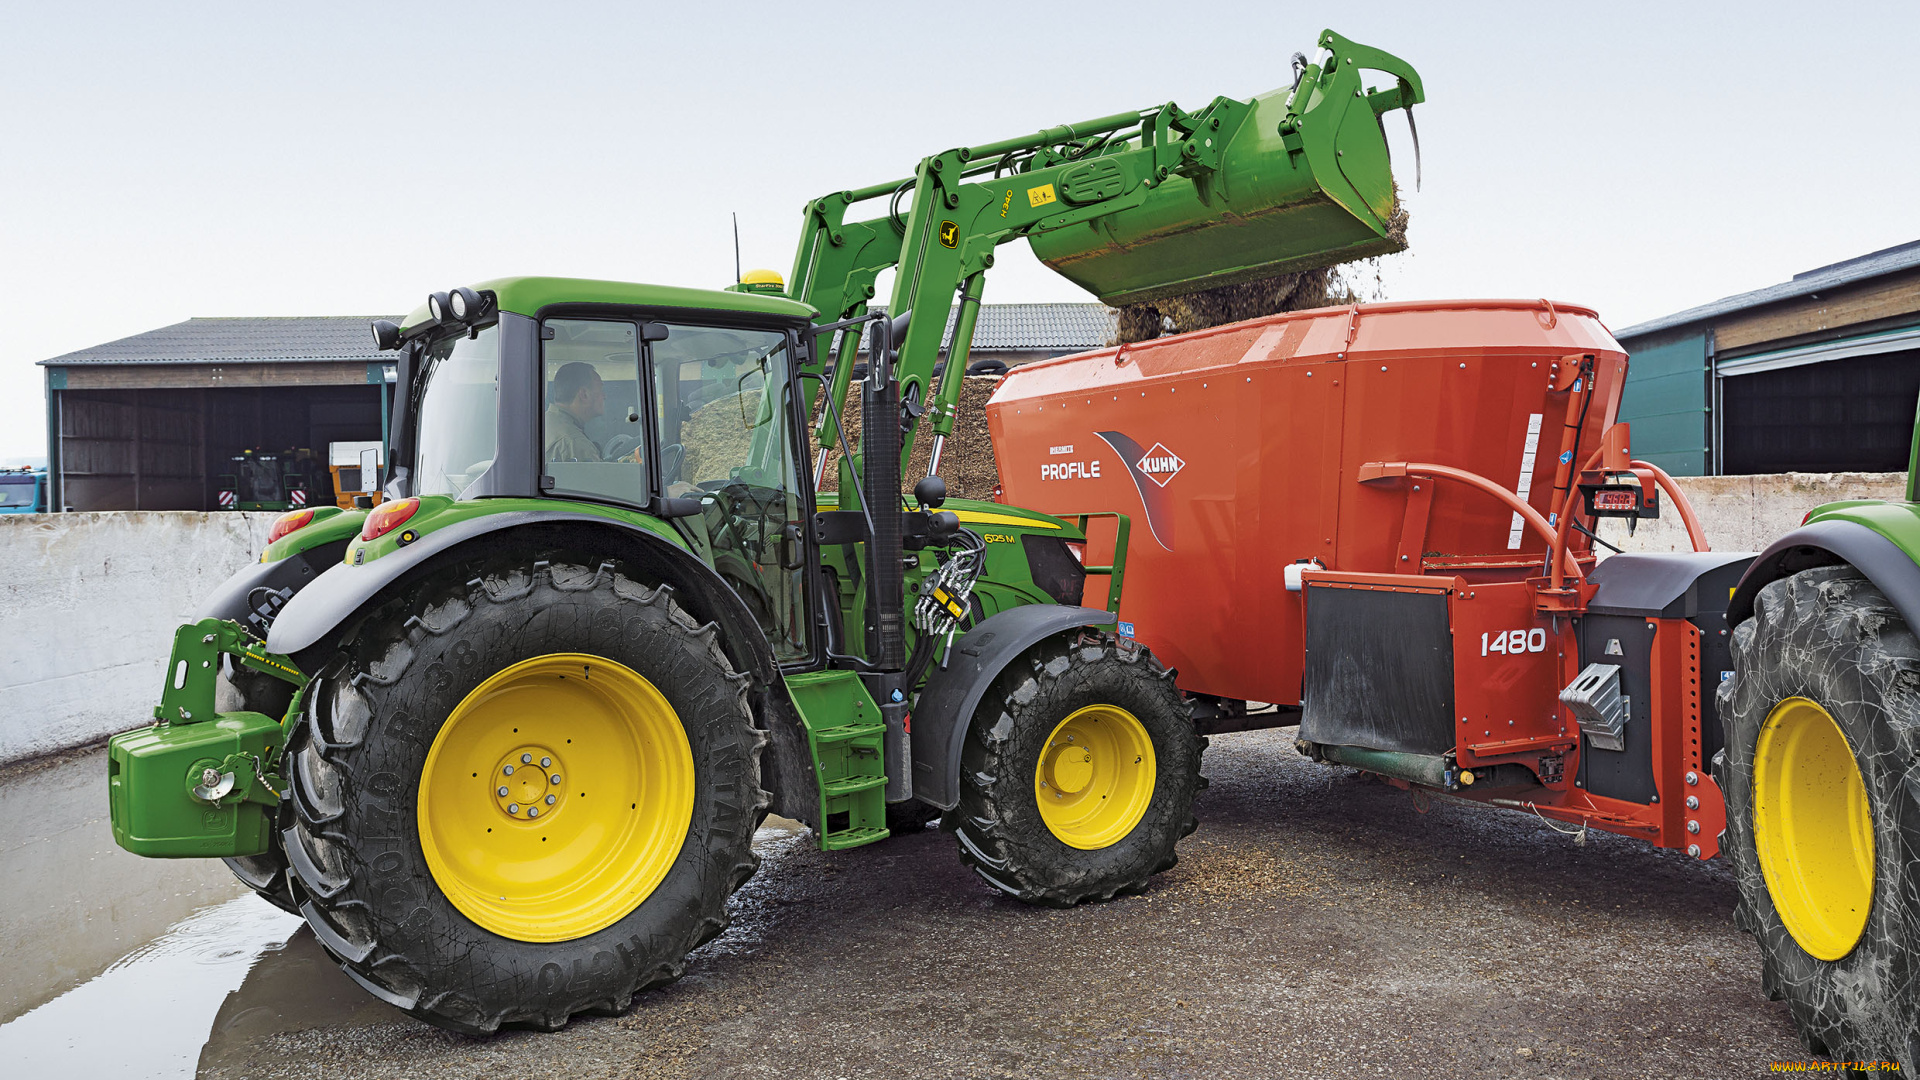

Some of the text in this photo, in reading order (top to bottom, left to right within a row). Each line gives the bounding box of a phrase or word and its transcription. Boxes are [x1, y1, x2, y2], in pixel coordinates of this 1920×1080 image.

[1041, 460, 1100, 480] PROFILE
[1142, 457, 1178, 473] KUHN
[1481, 628, 1546, 656] 1480
[424, 639, 479, 692] 38
[593, 607, 743, 847] CONTINENTAL
